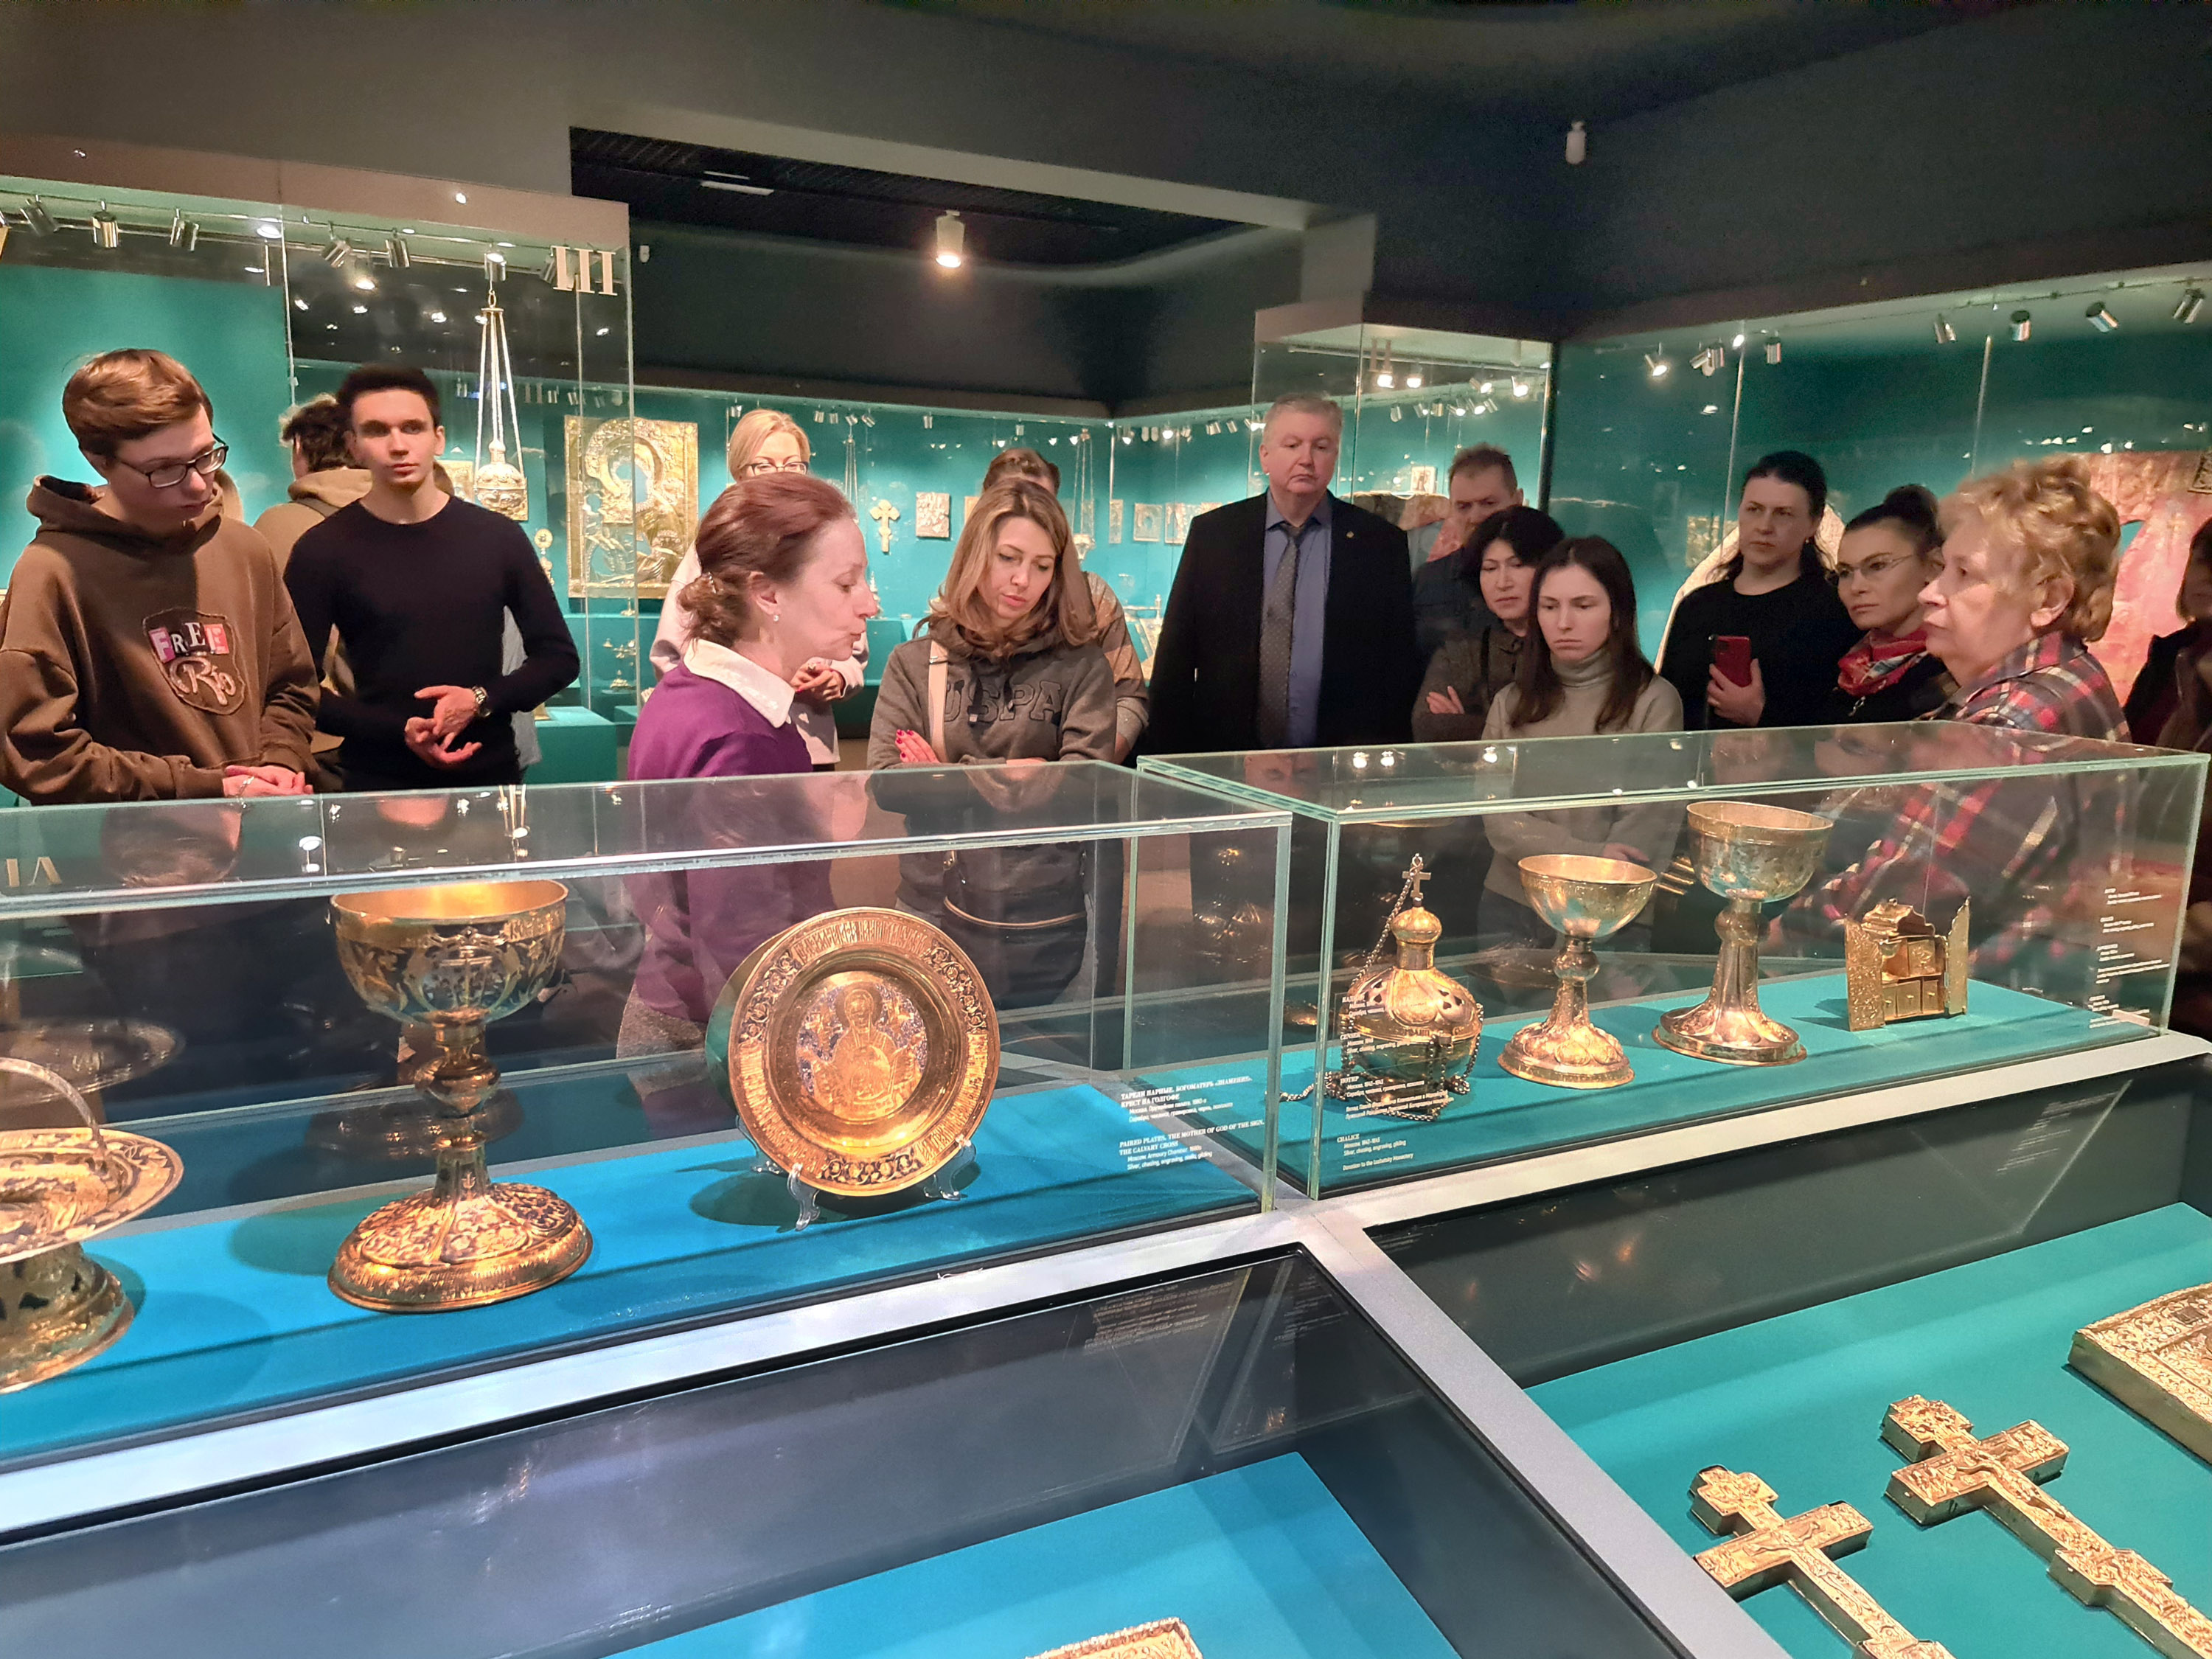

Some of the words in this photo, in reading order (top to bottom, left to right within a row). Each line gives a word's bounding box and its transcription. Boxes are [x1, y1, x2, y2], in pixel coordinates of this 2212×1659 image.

[551, 245, 618, 296] III
[1119, 1138, 1142, 1148] PAIRED
[1167, 1132, 1180, 1140] THE
[1181, 1127, 1206, 1138] MOTHER
[1215, 1124, 1228, 1133] GOD
[1337, 1133, 1360, 1143] CHALICE
[1119, 1147, 1133, 1156] THE
[1133, 1144, 1159, 1153] CALVARY
[1159, 1140, 1179, 1150] CROSS
